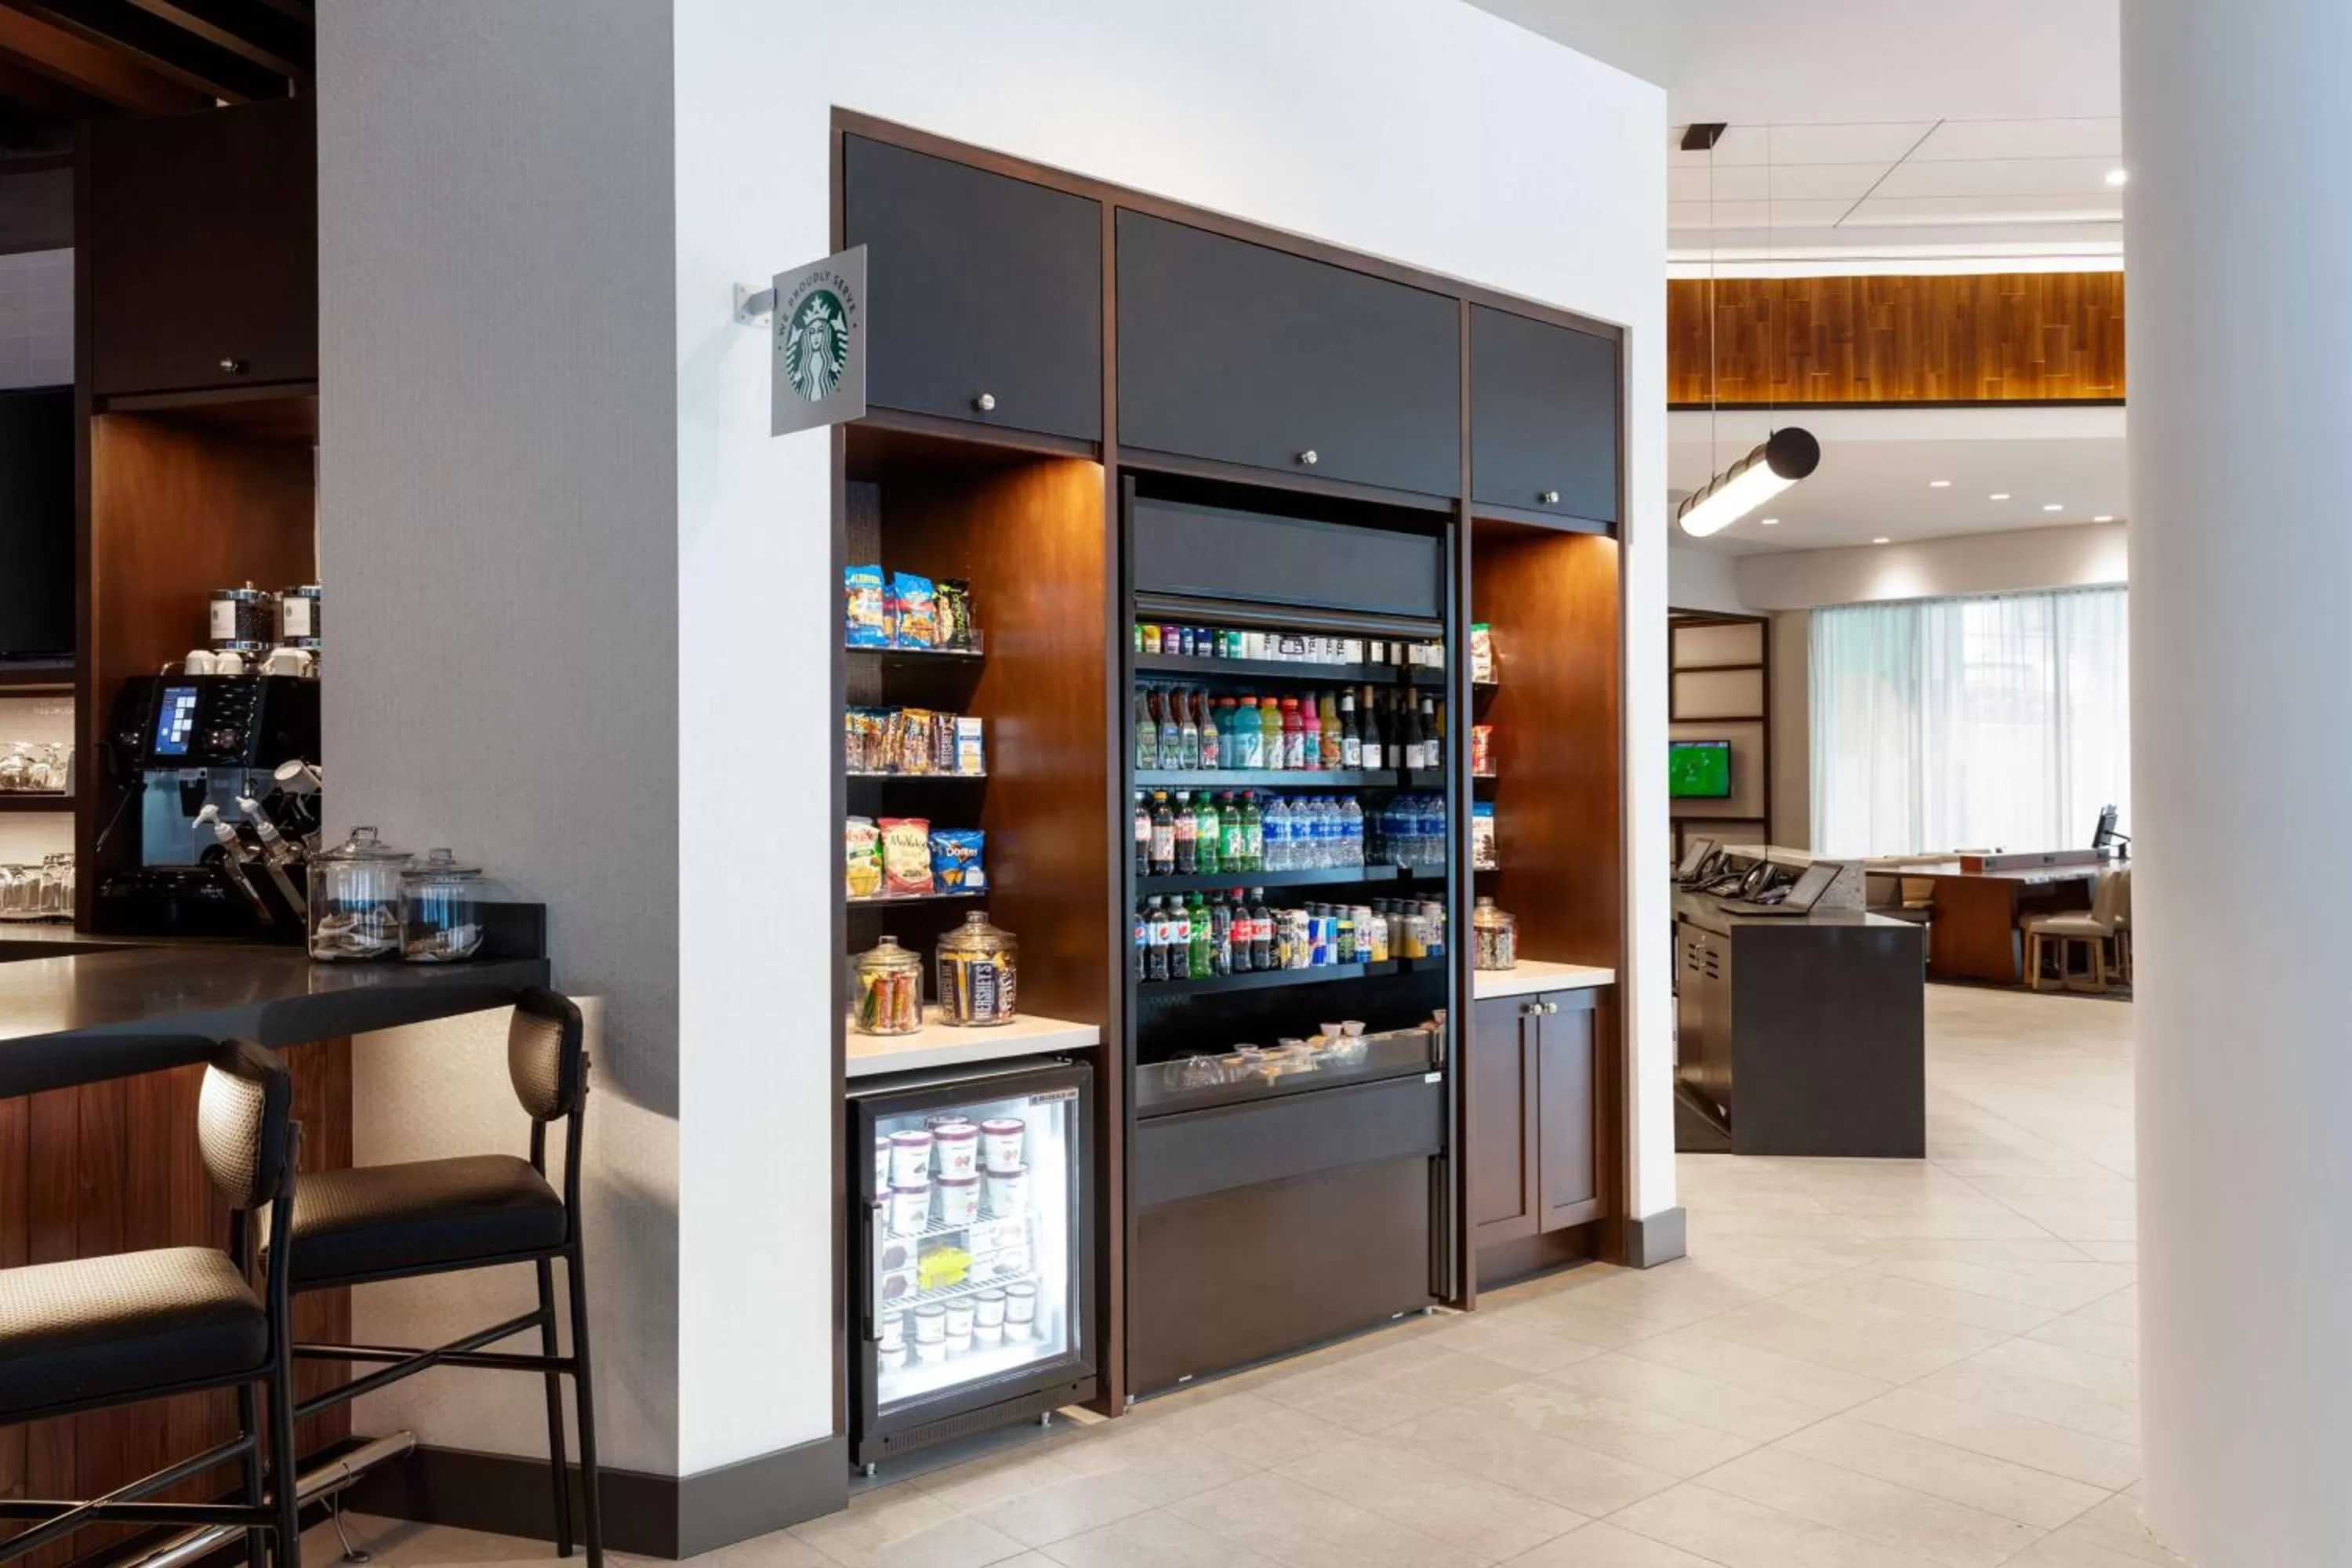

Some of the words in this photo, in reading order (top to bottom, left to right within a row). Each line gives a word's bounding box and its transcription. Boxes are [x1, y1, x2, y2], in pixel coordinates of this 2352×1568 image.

[788, 270, 830, 307] PROUDLY
[833, 274, 855, 314] SERVE
[975, 965, 992, 1019] HERSHEY'S
